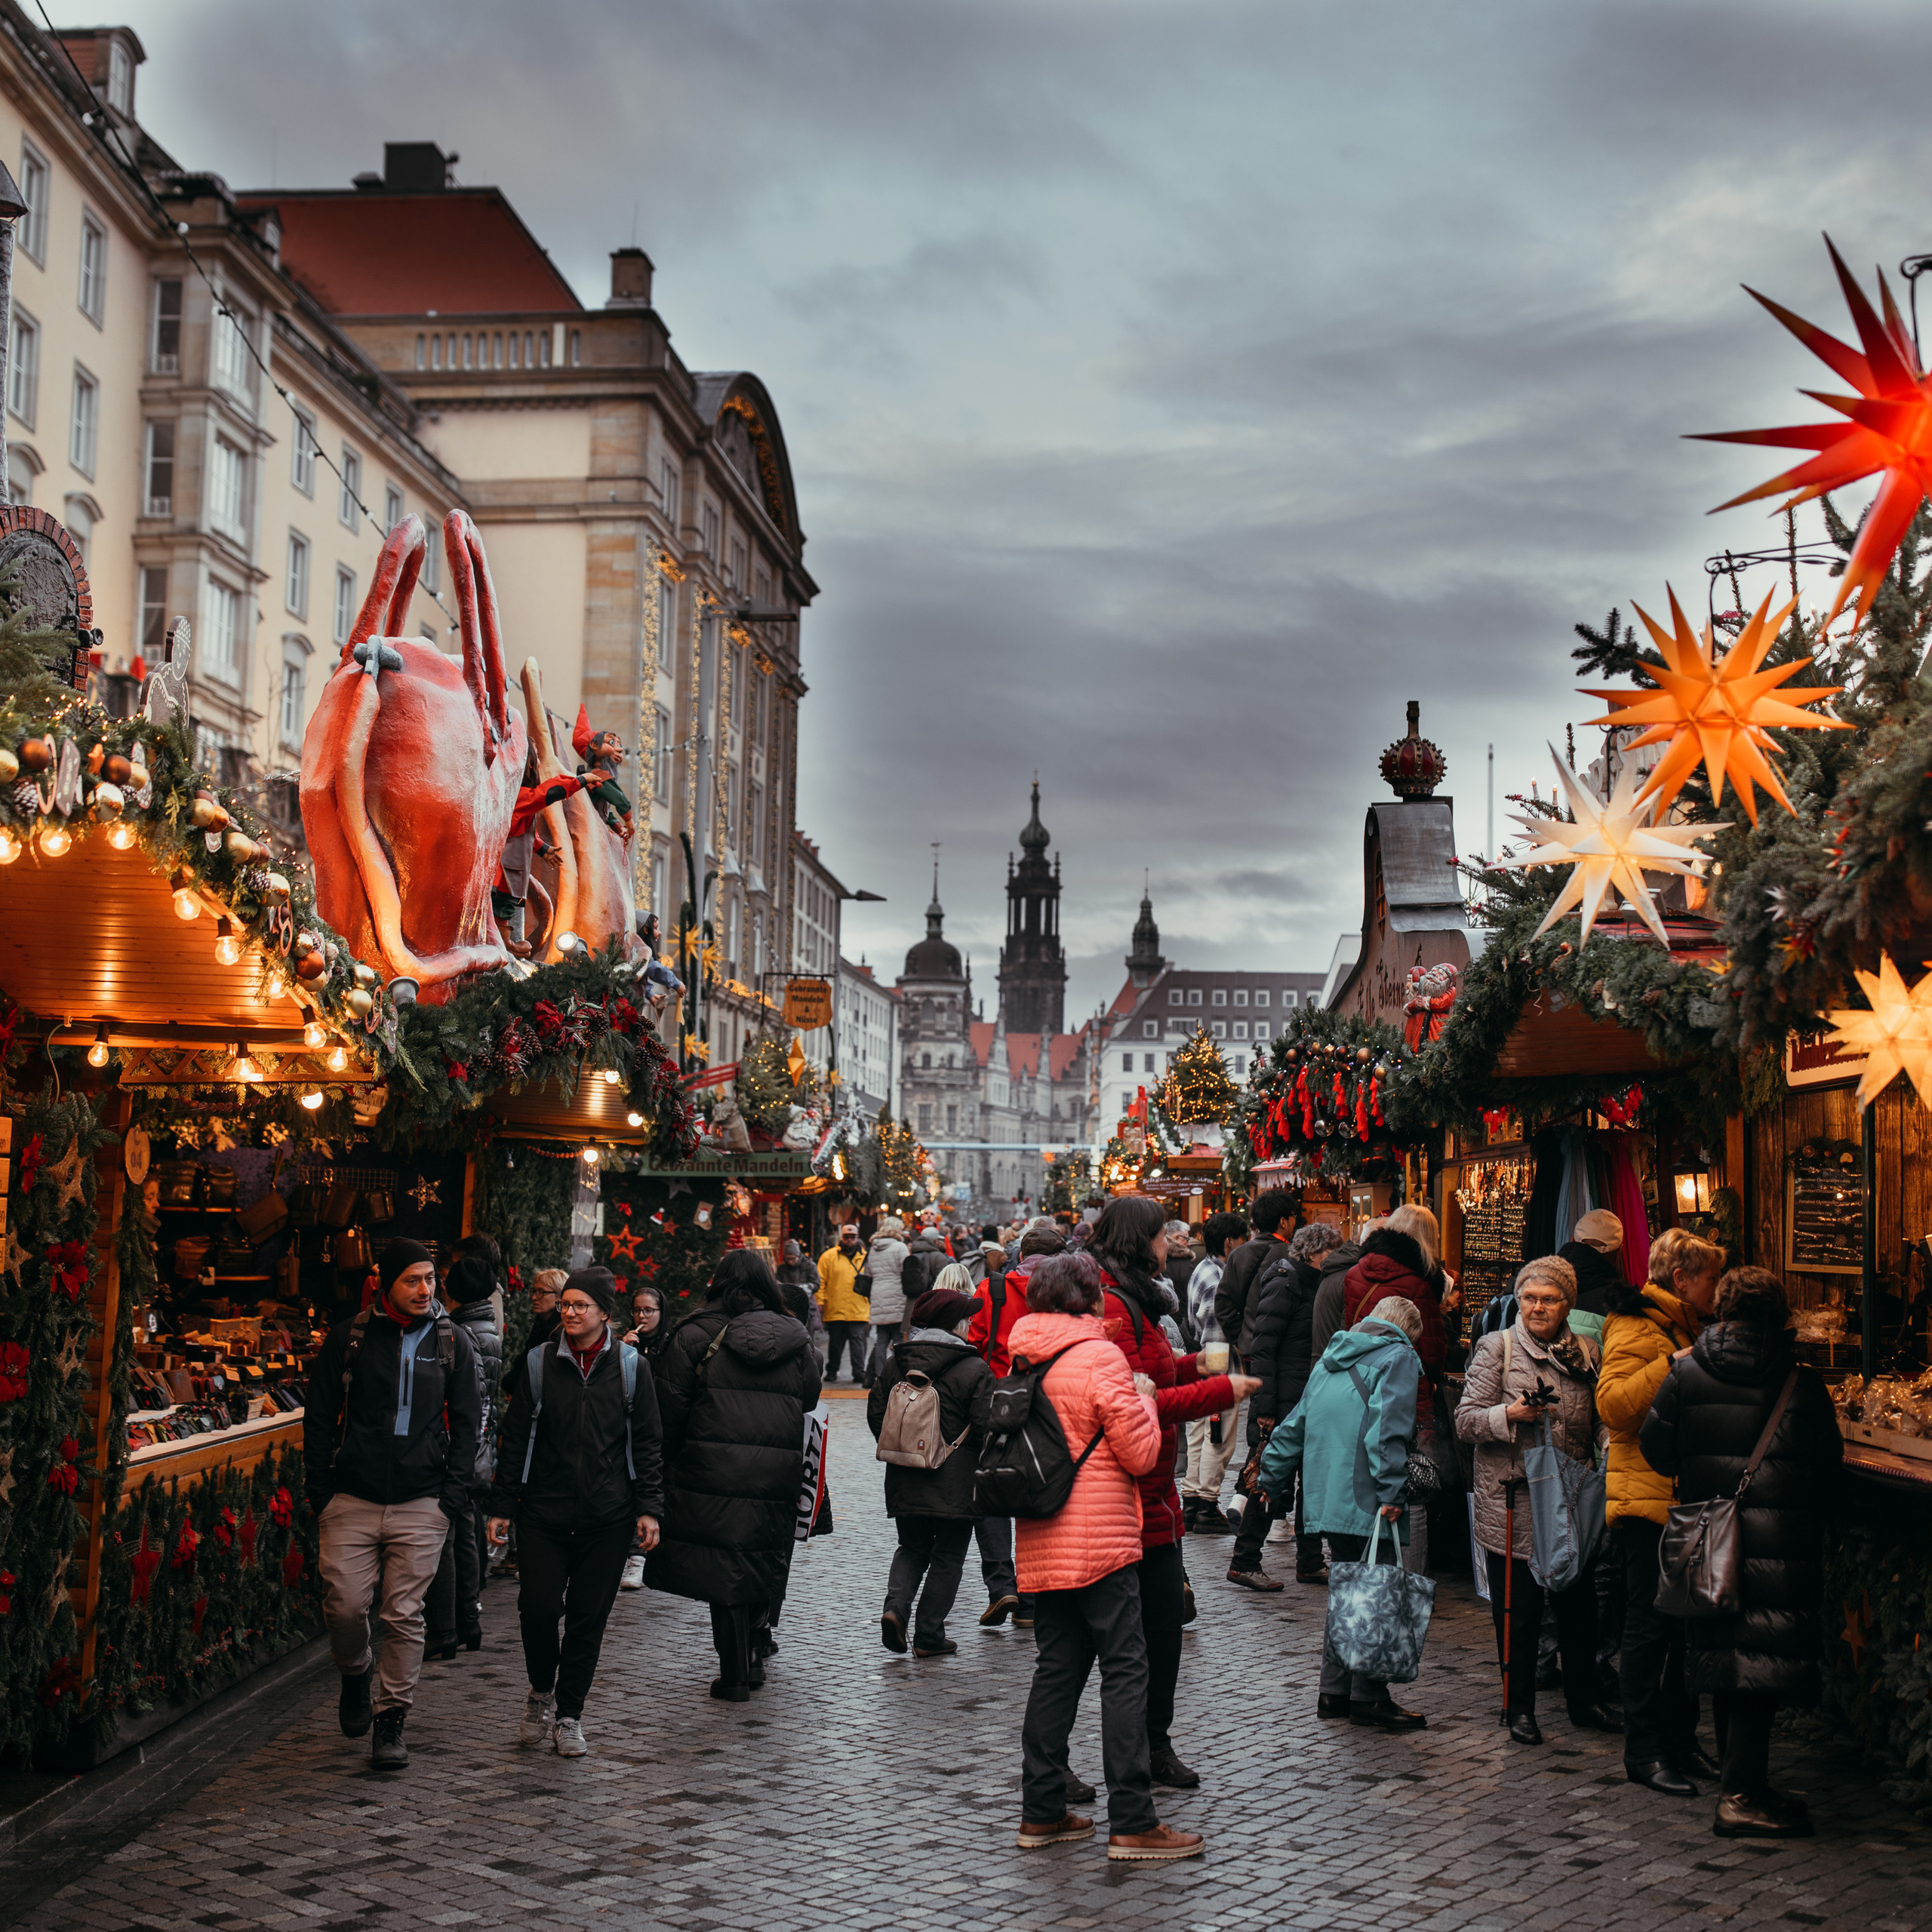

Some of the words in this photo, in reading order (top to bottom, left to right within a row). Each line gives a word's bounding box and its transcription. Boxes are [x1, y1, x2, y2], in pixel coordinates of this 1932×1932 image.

[789, 985, 828, 993] Gebrannte
[130, 1151, 142, 1169] 04
[734, 1158, 803, 1172] Mandeln
